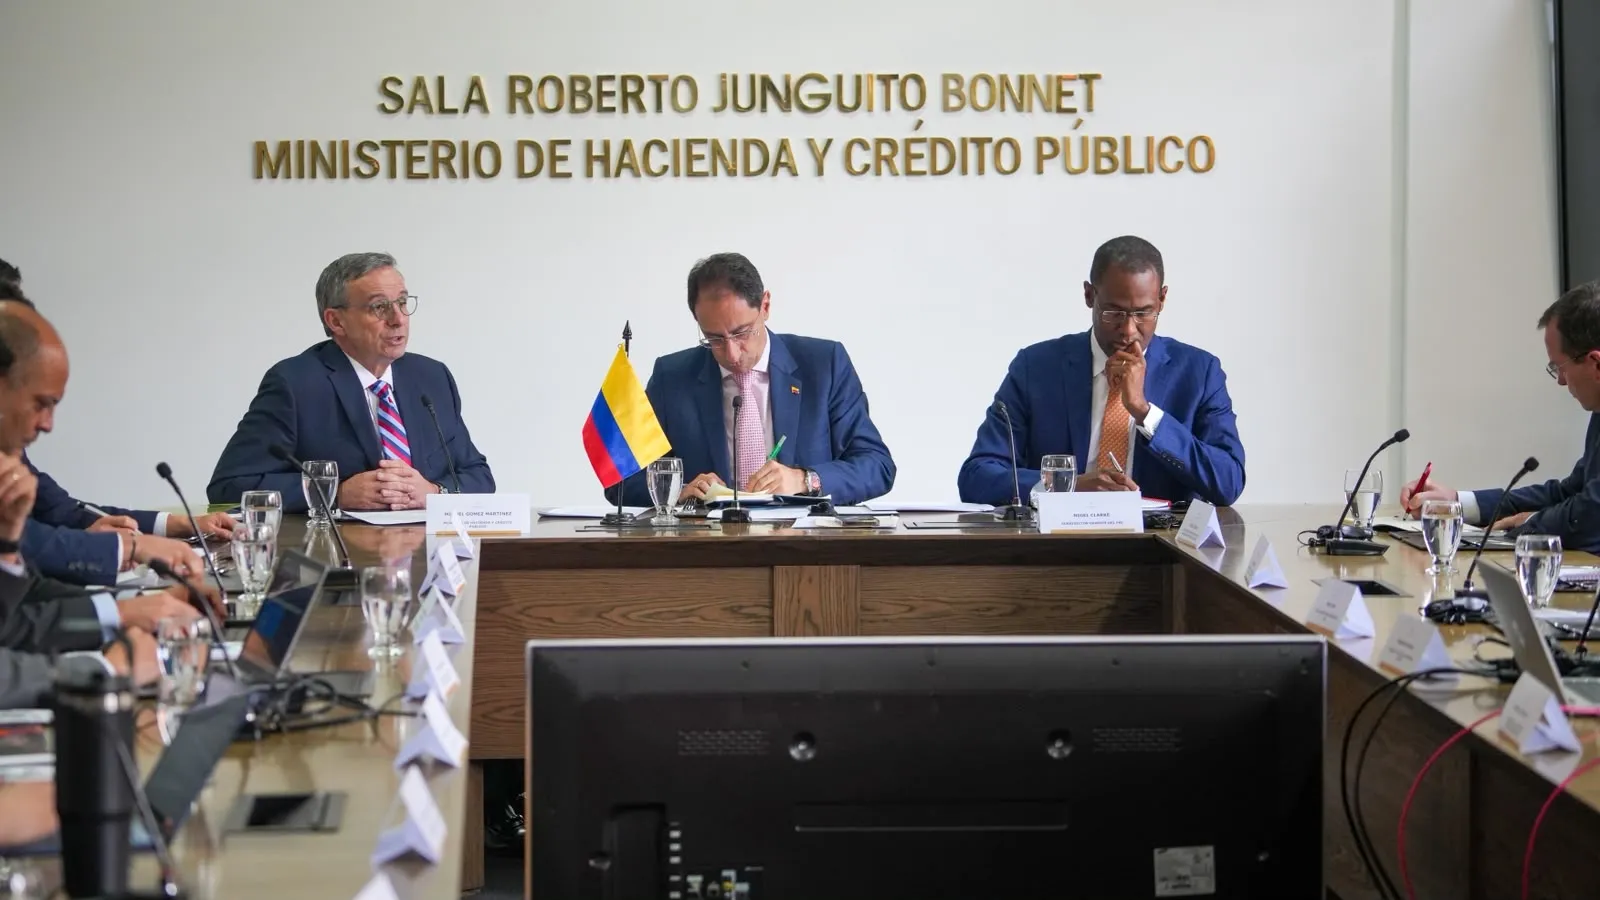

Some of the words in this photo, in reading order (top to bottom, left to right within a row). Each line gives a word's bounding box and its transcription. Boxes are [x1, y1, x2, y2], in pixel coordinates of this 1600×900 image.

[378, 75, 489, 114] SALA
[509, 74, 698, 113] ROBERTO
[714, 73, 926, 112] JUNGUITO
[943, 73, 1102, 113] BONNET
[255, 140, 502, 179] MINISTERIO
[517, 140, 572, 178] DE
[586, 138, 797, 177] HACIENDA
[808, 139, 832, 175] Y
[845, 120, 1021, 175] CRÉDITO
[1037, 119, 1215, 174] PÚBLICO
